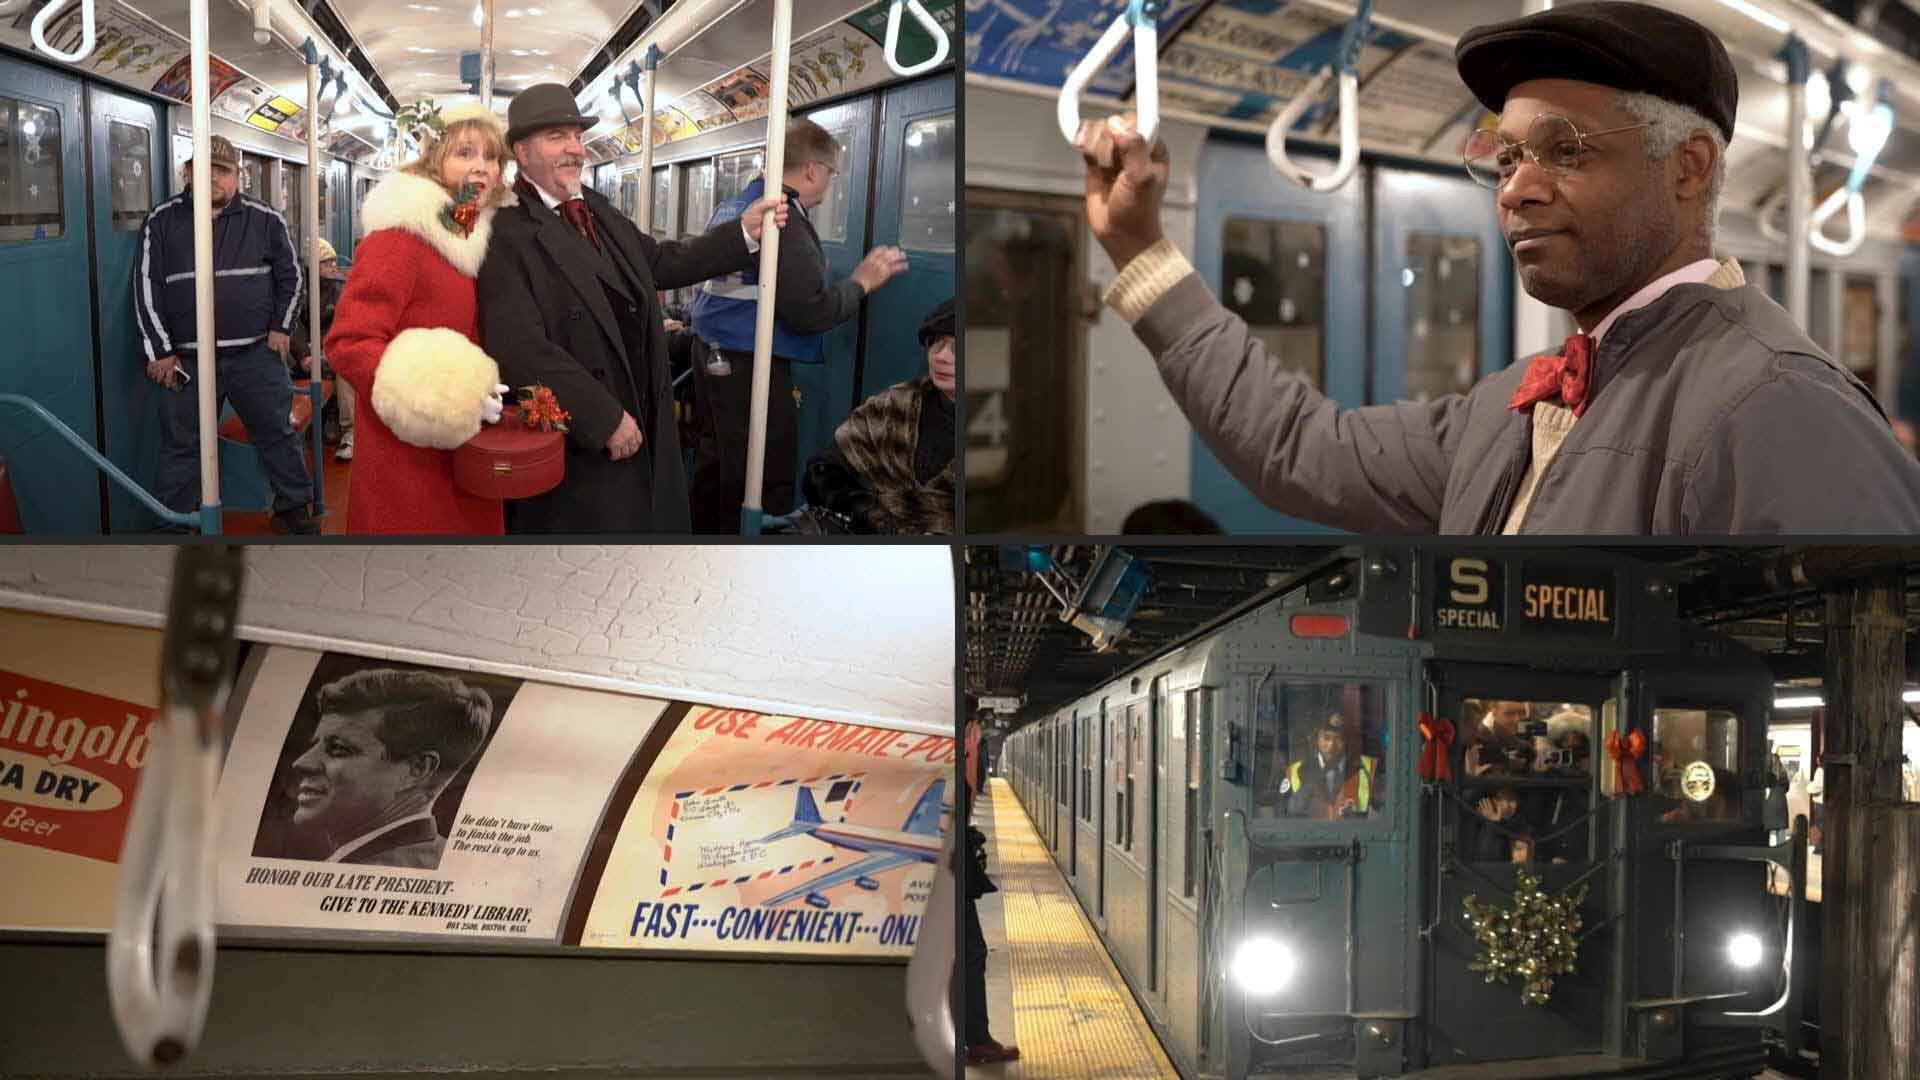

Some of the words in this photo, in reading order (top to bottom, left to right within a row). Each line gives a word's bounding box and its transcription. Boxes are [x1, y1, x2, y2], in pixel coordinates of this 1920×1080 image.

[1450, 557, 1488, 604] S
[1525, 583, 1610, 622] SPECIAL
[1437, 607, 1500, 630] SPECIAL
[694, 706, 758, 739] USE
[34, 769, 99, 803] DRY
[2, 806, 61, 837] Beer
[456, 828, 467, 838] to
[466, 829, 497, 842] finish
[497, 832, 514, 843] the
[460, 814, 475, 825] He
[507, 819, 531, 831] have
[530, 823, 553, 833] time
[452, 840, 471, 851] The
[472, 843, 492, 853] rest
[491, 844, 502, 853] is
[502, 846, 516, 857] up
[516, 847, 527, 857] to
[245, 867, 301, 887] HONOR
[302, 871, 335, 889] OUR
[335, 873, 376, 892] LATE
[319, 895, 357, 913] GIVE
[357, 898, 378, 914] TO
[378, 899, 409, 915] THE
[408, 901, 474, 919] KENNEDY
[879, 914, 926, 945] ONL
